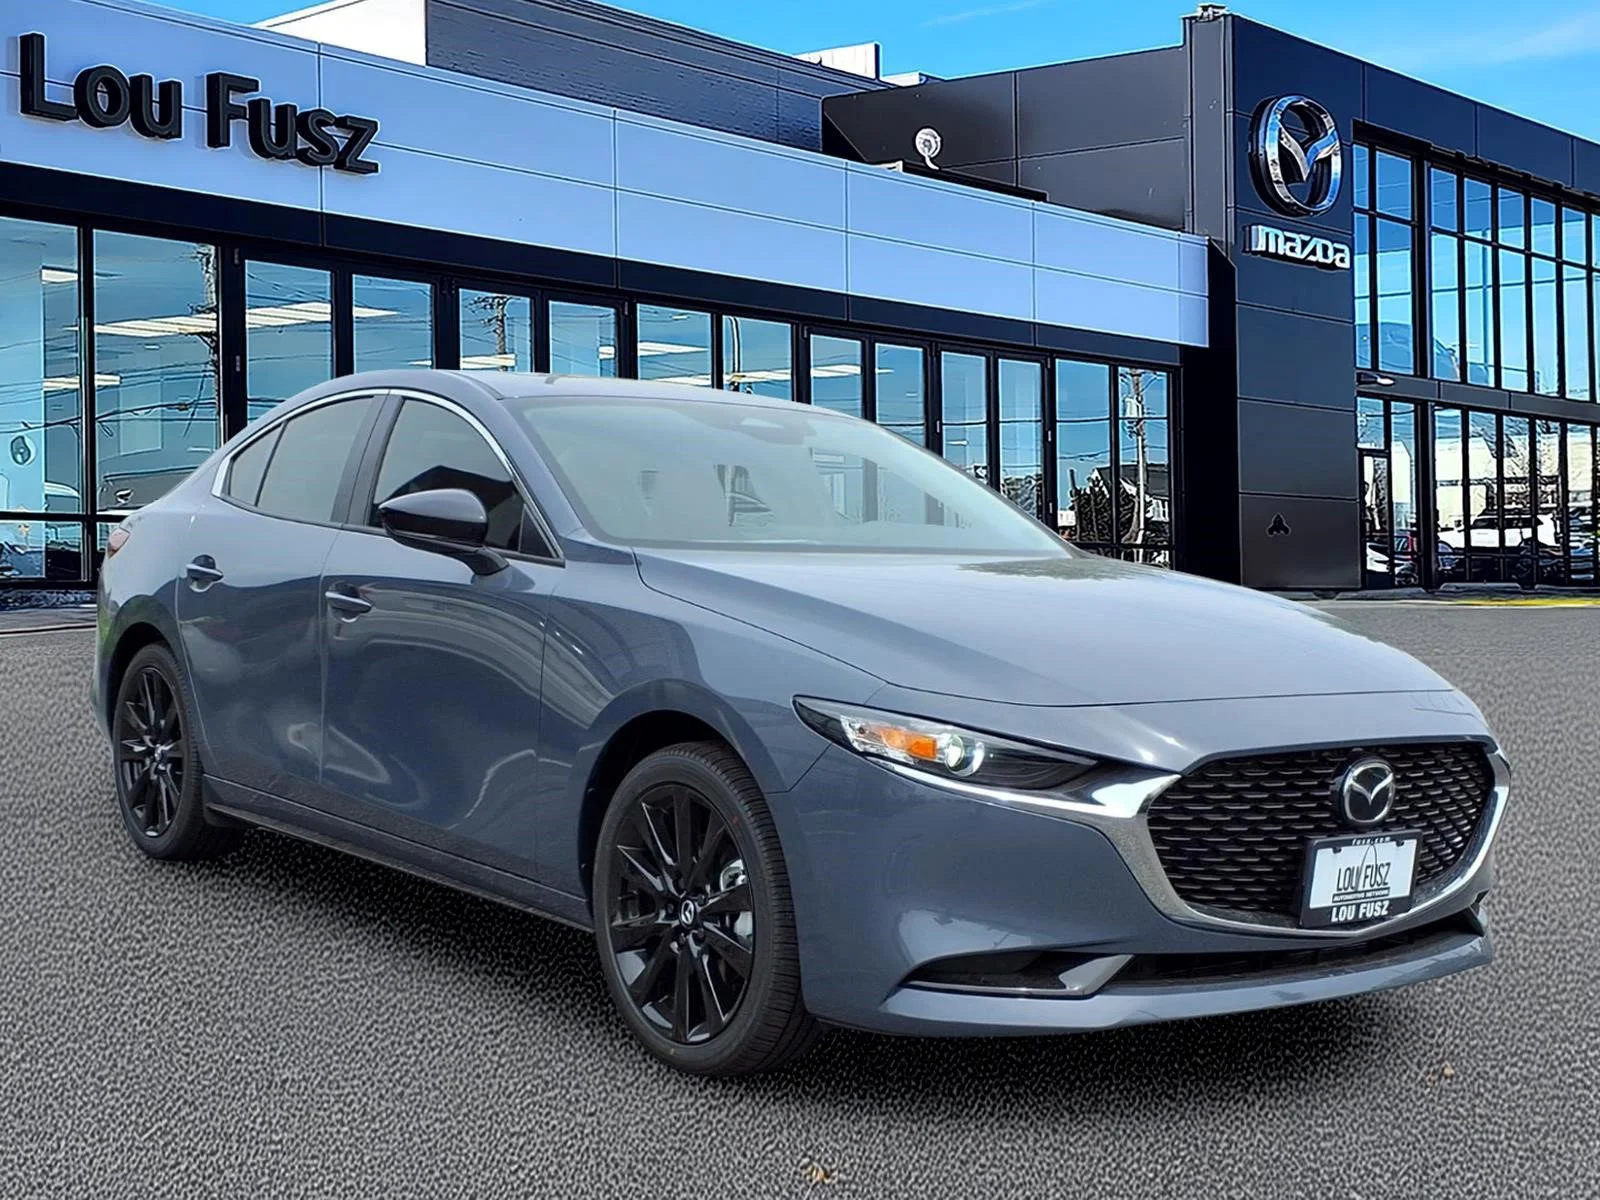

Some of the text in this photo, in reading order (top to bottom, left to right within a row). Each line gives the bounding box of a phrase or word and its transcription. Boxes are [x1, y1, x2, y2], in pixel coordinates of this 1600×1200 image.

[20, 33, 380, 175] Lou Fusz
[1336, 862, 1391, 892] LOU FUSZ
[1331, 900, 1390, 923] LOU FUSZ
